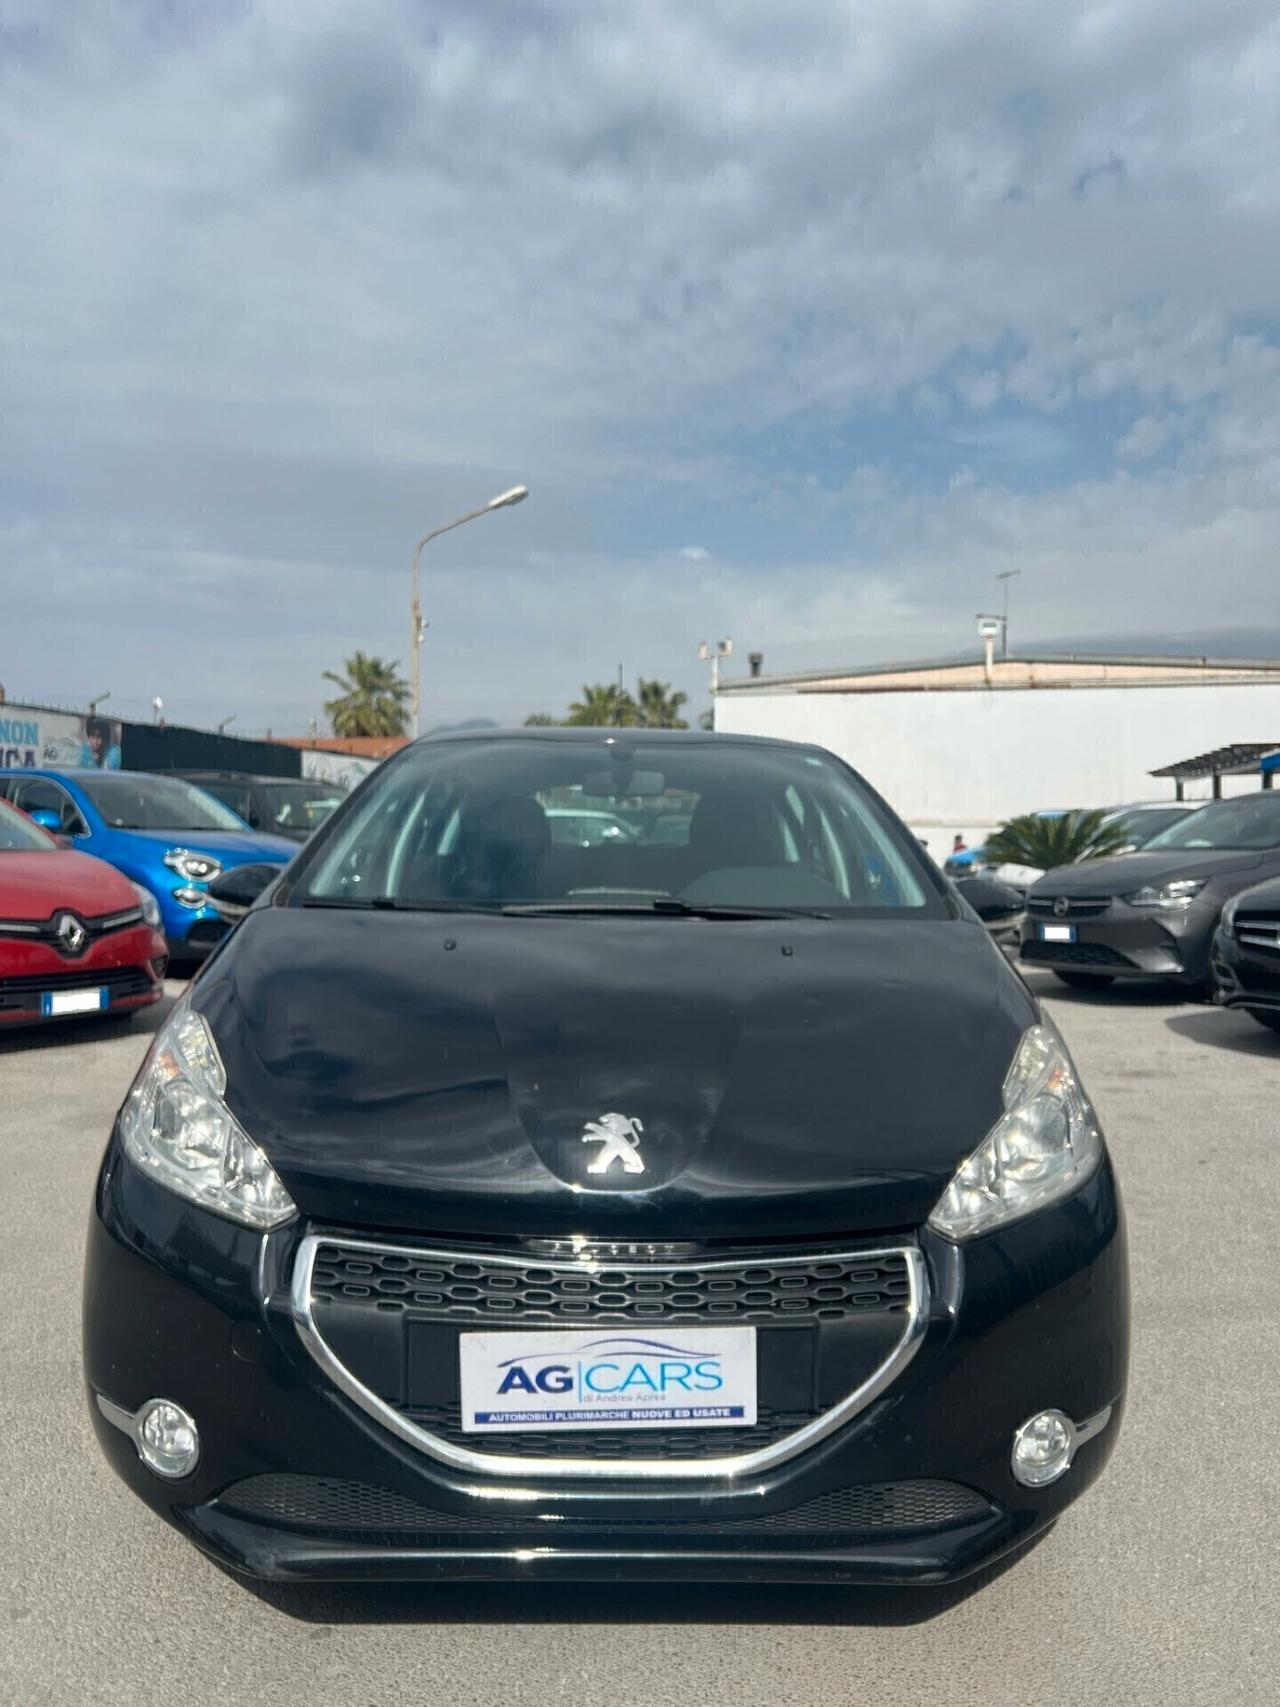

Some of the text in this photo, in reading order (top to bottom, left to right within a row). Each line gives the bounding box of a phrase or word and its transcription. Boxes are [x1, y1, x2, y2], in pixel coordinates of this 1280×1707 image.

[496, 1361, 723, 1394] AG CARS
[488, 1408, 732, 1423] AUTOMOBILI PLURIMARCHE NUOVE ED USATE
